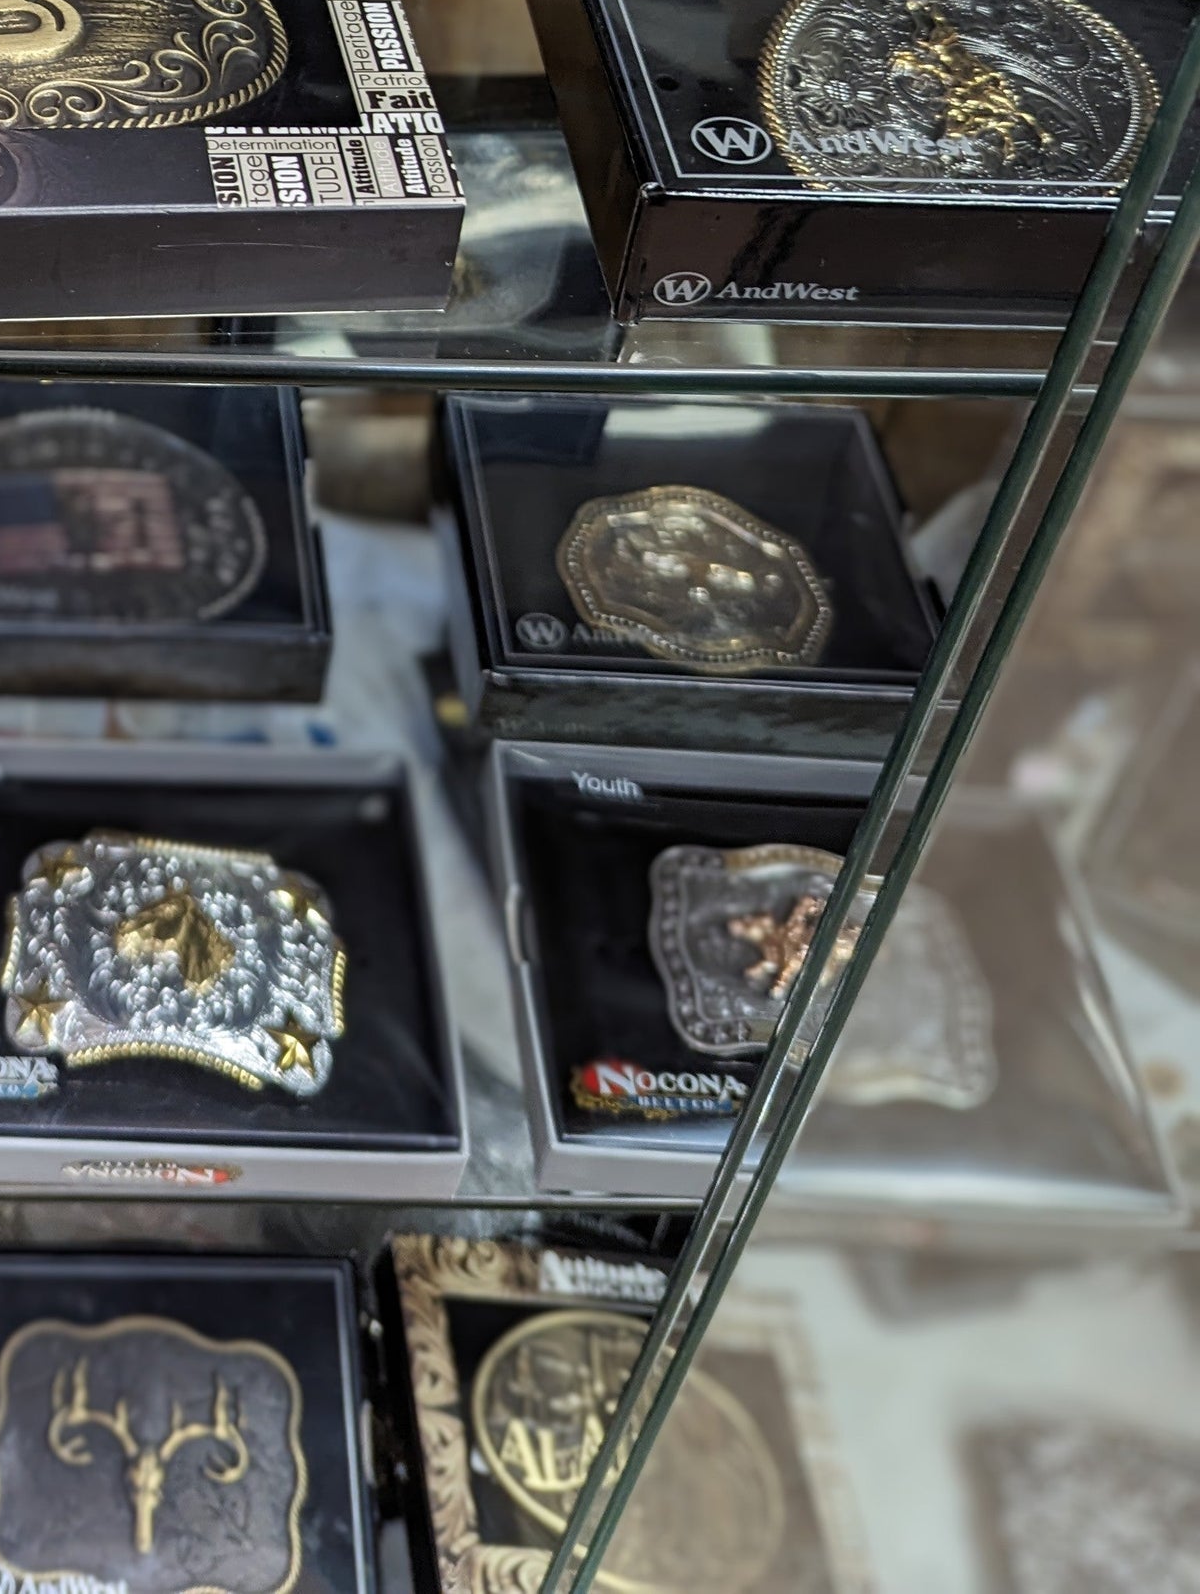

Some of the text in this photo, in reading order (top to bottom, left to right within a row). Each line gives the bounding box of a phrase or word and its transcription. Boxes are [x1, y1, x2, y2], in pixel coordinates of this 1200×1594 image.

[341, 0, 375, 72] Heritage
[362, 2, 409, 71] PASSION
[365, 91, 436, 109] Fait
[208, 139, 337, 151] Determination
[787, 129, 982, 157] AndWest
[312, 155, 345, 203] TUDE
[348, 139, 376, 194] Attitude
[395, 139, 427, 195] Attitude
[422, 137, 451, 195] Passion
[715, 281, 860, 301] AndWest
[571, 770, 640, 798] Youth
[595, 1062, 749, 1101] NOCONA
